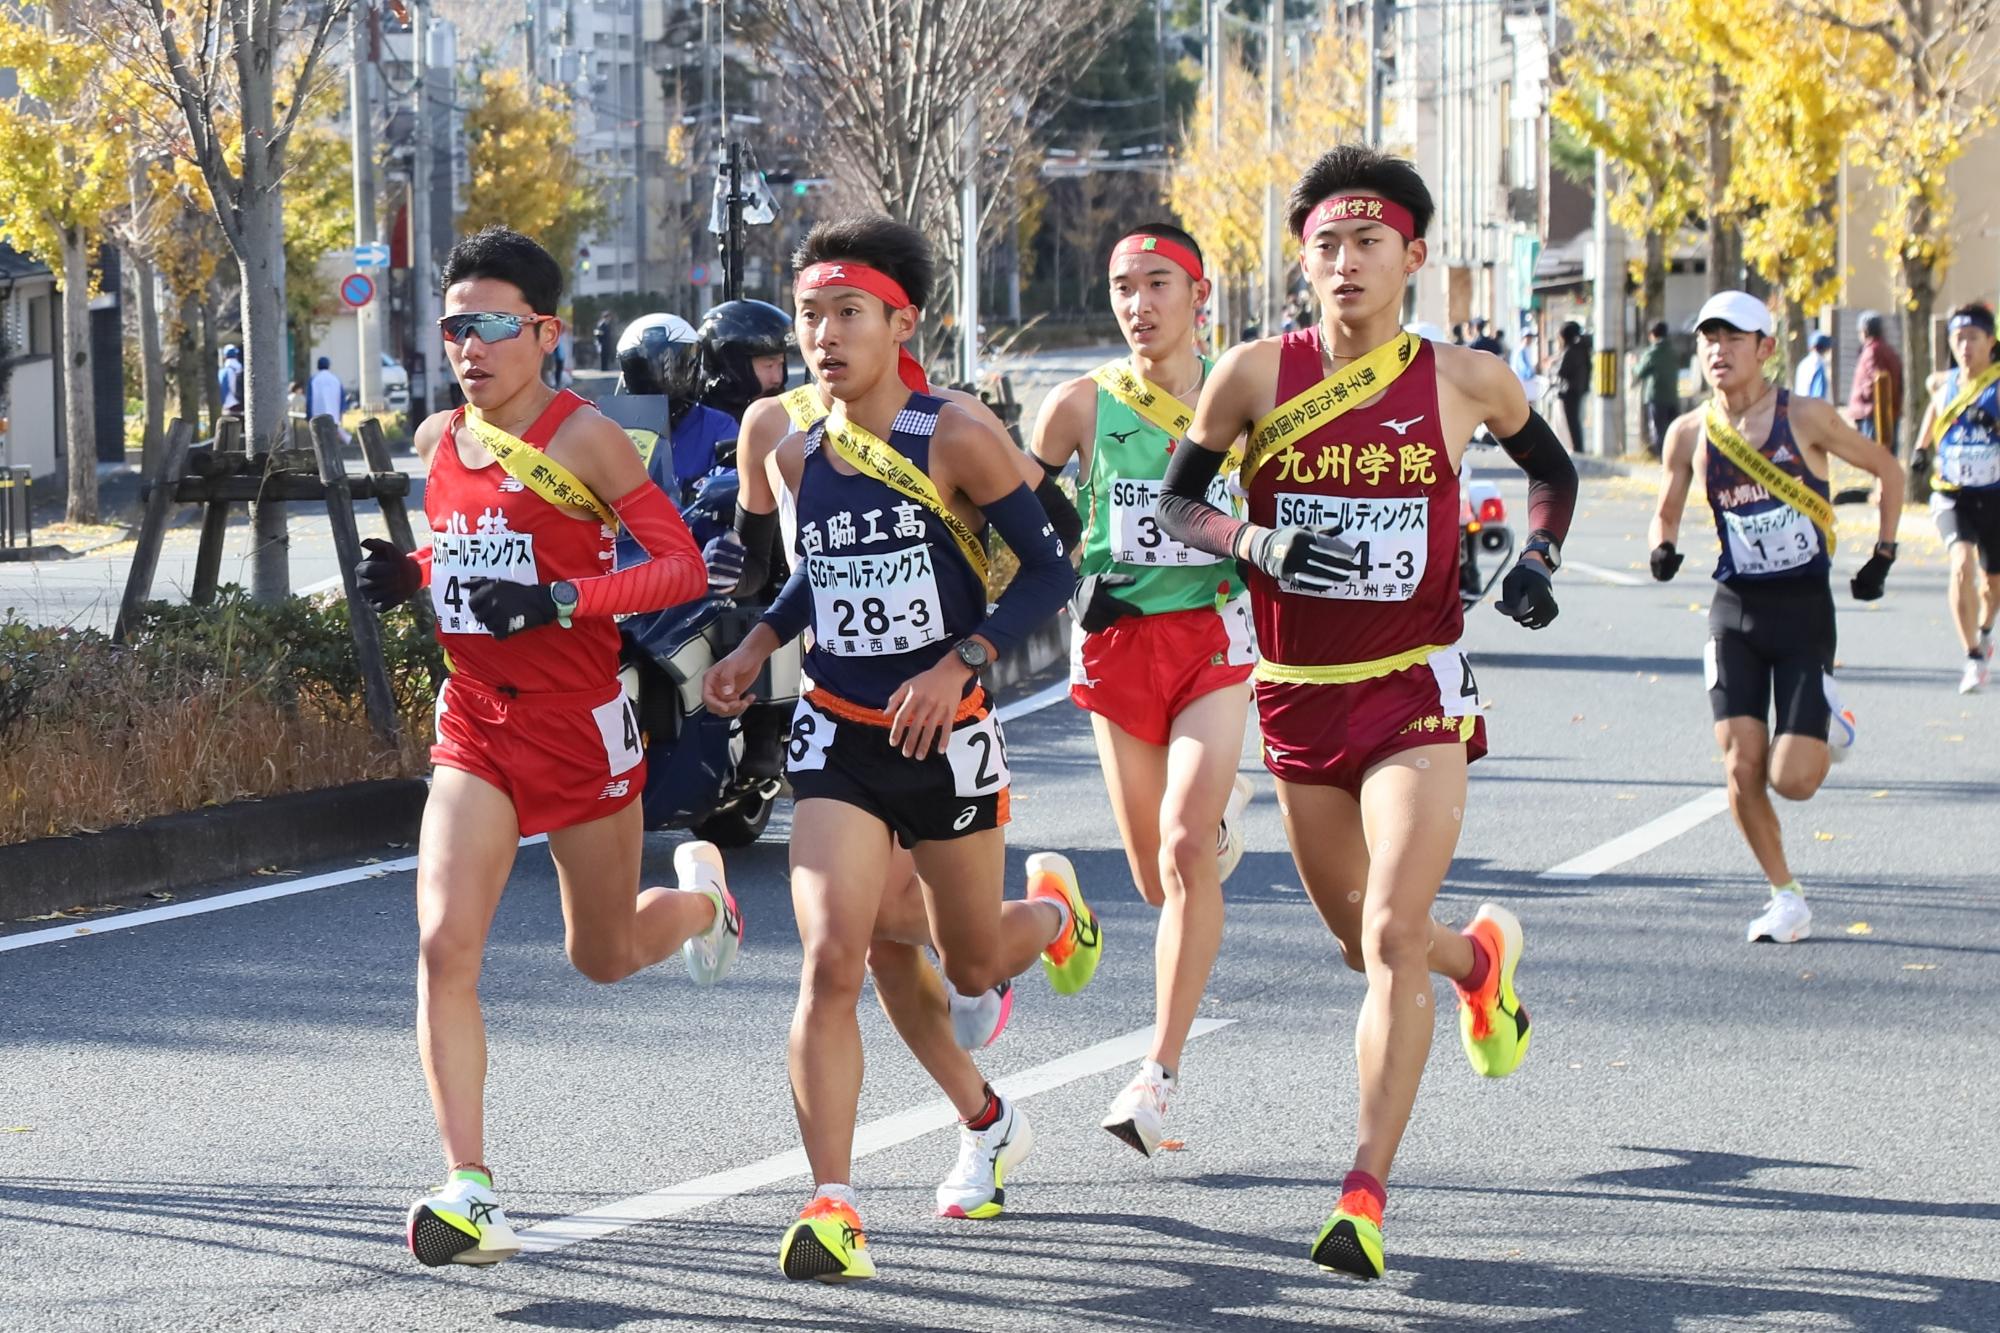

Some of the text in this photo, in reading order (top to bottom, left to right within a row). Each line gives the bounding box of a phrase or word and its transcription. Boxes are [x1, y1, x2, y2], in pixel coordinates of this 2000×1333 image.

[1275, 443, 1437, 487] 九州学院
[801, 500, 927, 558] 西脇工高
[1280, 498, 1425, 532] SGホールディングス
[810, 551, 931, 590] SGホールディングス
[832, 597, 930, 638] 28-3
[1399, 714, 1459, 735] 州学院
